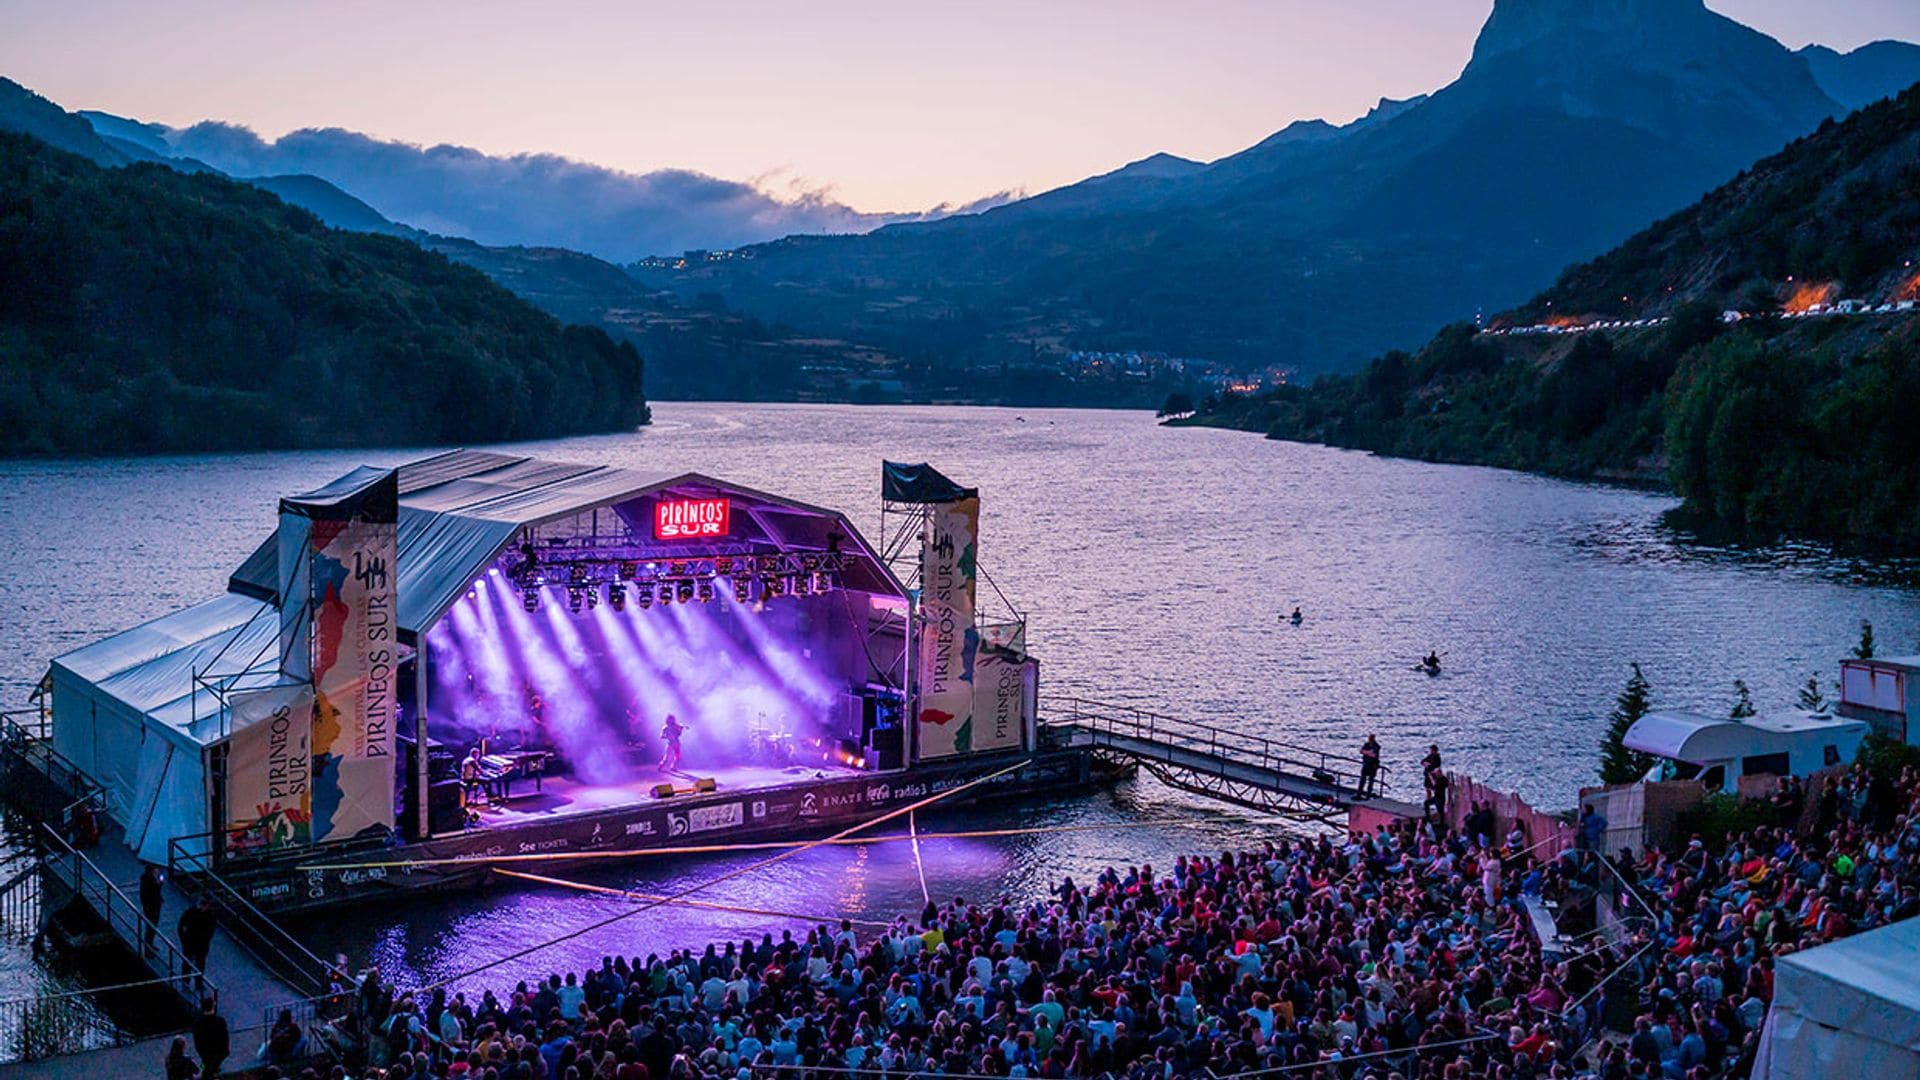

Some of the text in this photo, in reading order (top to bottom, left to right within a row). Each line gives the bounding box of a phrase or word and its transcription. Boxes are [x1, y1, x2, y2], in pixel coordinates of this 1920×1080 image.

[661, 501, 723, 525] PIRINEOS
[661, 522, 720, 536] SUR
[933, 564, 954, 693] PIRINEOS SUR
[367, 594, 390, 758] PIRINEOS SUR
[1009, 666, 1024, 697] SUR
[996, 667, 1012, 738] PIRINEOS
[269, 705, 291, 799] PIRINEOS
[289, 753, 307, 795] SUR
[823, 792, 862, 807] ENATE
[519, 842, 536, 853] See
